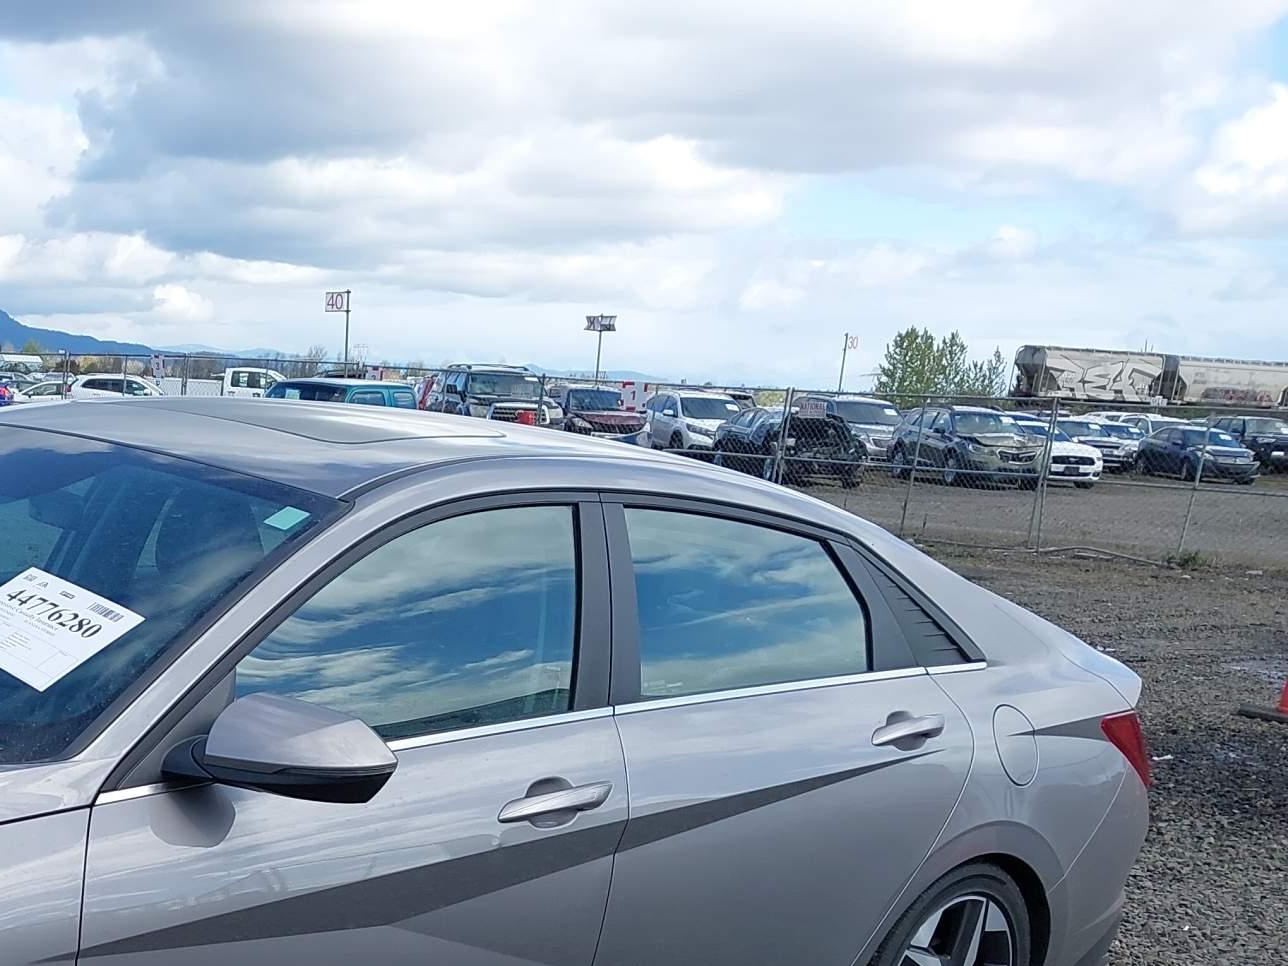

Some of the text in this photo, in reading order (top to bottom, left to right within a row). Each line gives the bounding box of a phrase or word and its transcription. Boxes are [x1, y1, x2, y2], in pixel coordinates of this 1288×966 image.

[327, 293, 343, 310] 40
[848, 336, 858, 350] 30
[630, 390, 636, 401] 1
[6, 589, 103, 639] 44776280
